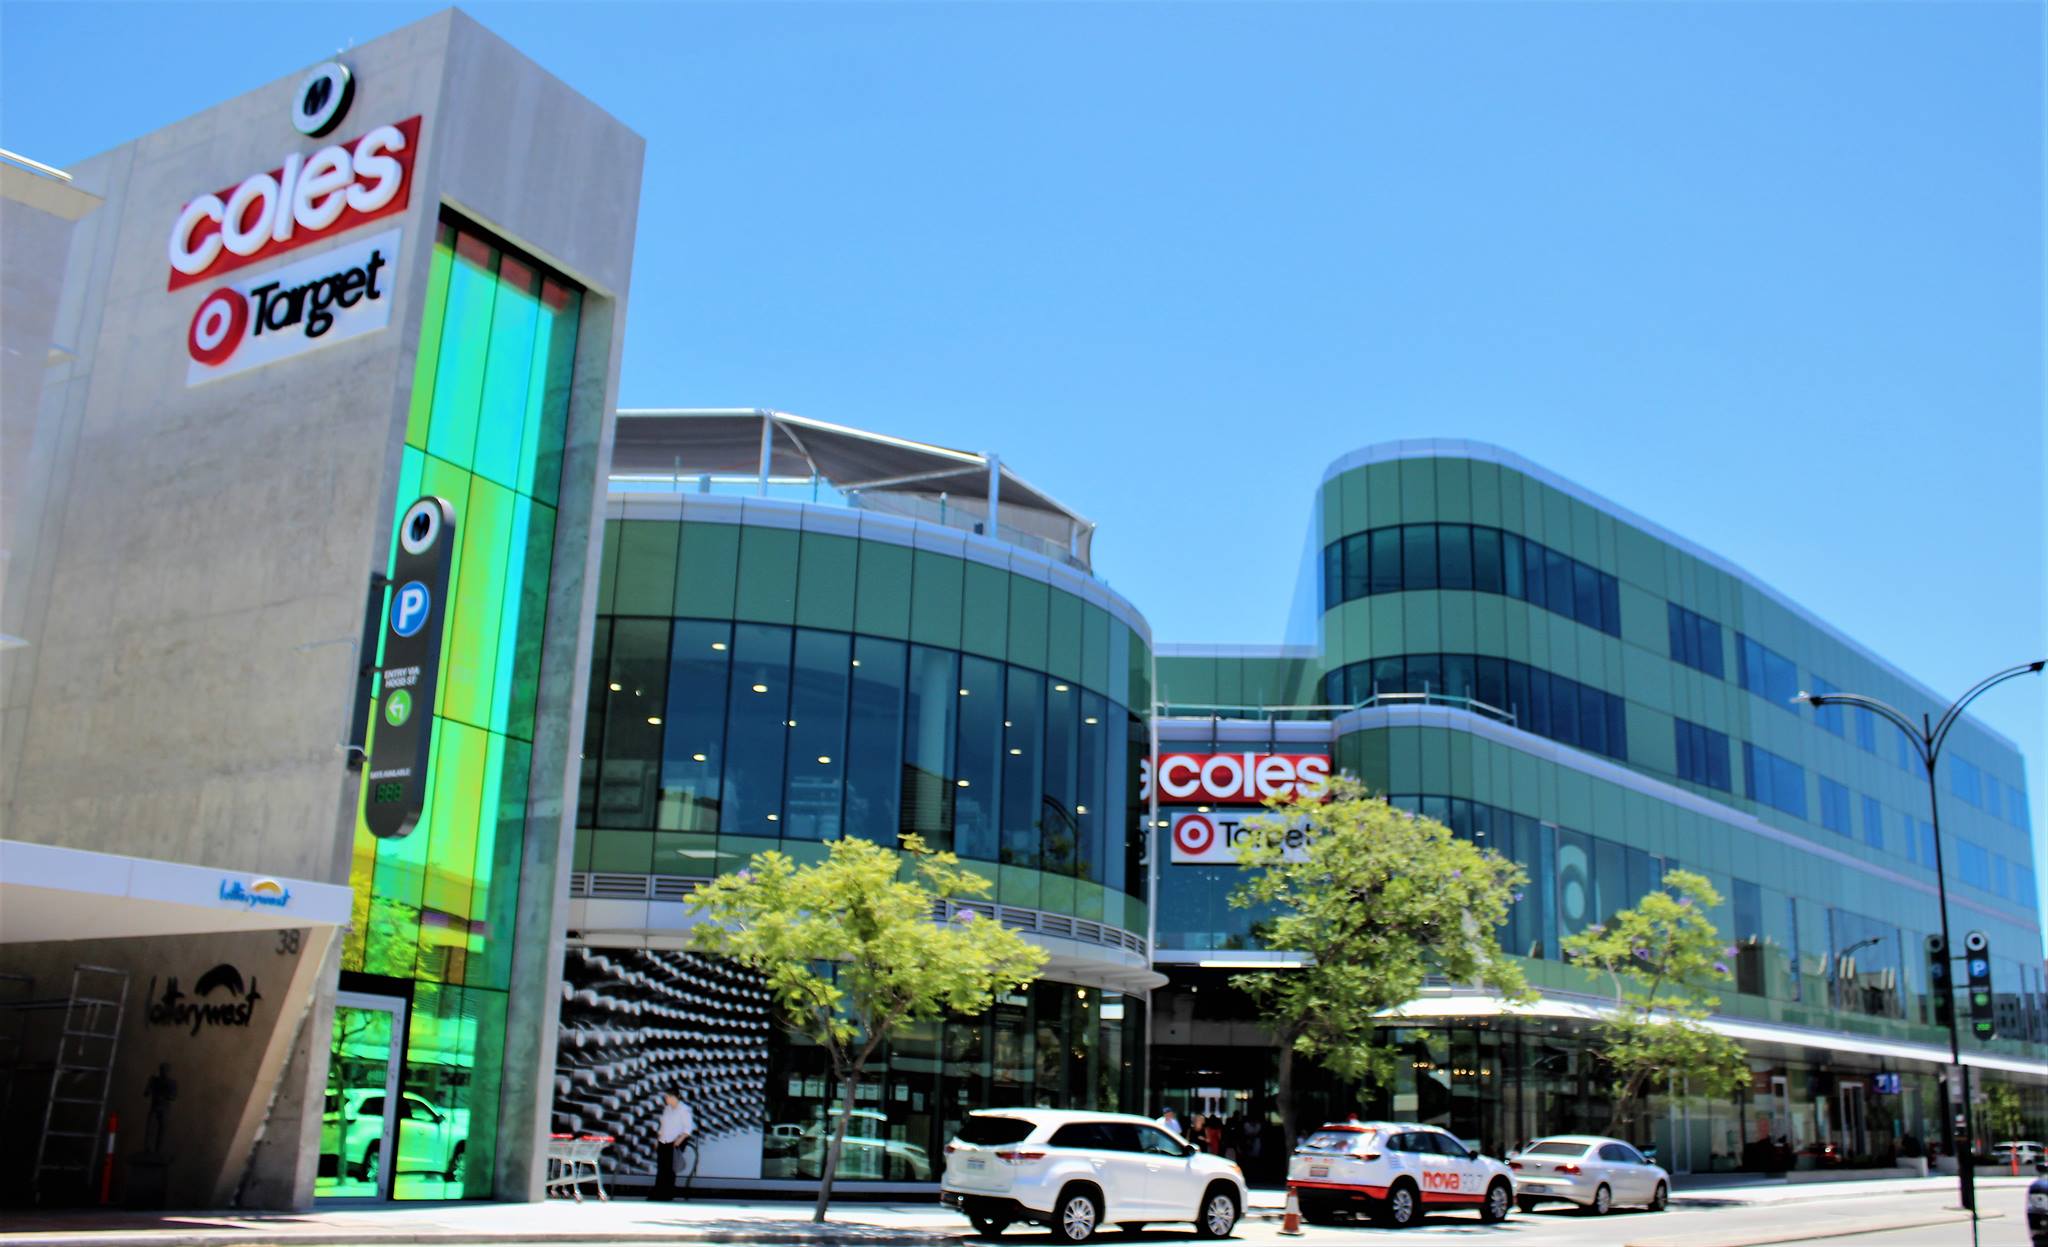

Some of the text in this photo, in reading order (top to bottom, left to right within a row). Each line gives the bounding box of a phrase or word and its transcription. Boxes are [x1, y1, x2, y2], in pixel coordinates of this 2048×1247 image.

[168, 125, 406, 275] coles
[250, 249, 386, 339] Target
[398, 587, 424, 630] P
[1158, 751, 1330, 799] coles
[276, 928, 300, 956] 38
[144, 975, 262, 1037] lotterywest
[1423, 1169, 1460, 1190] nova
